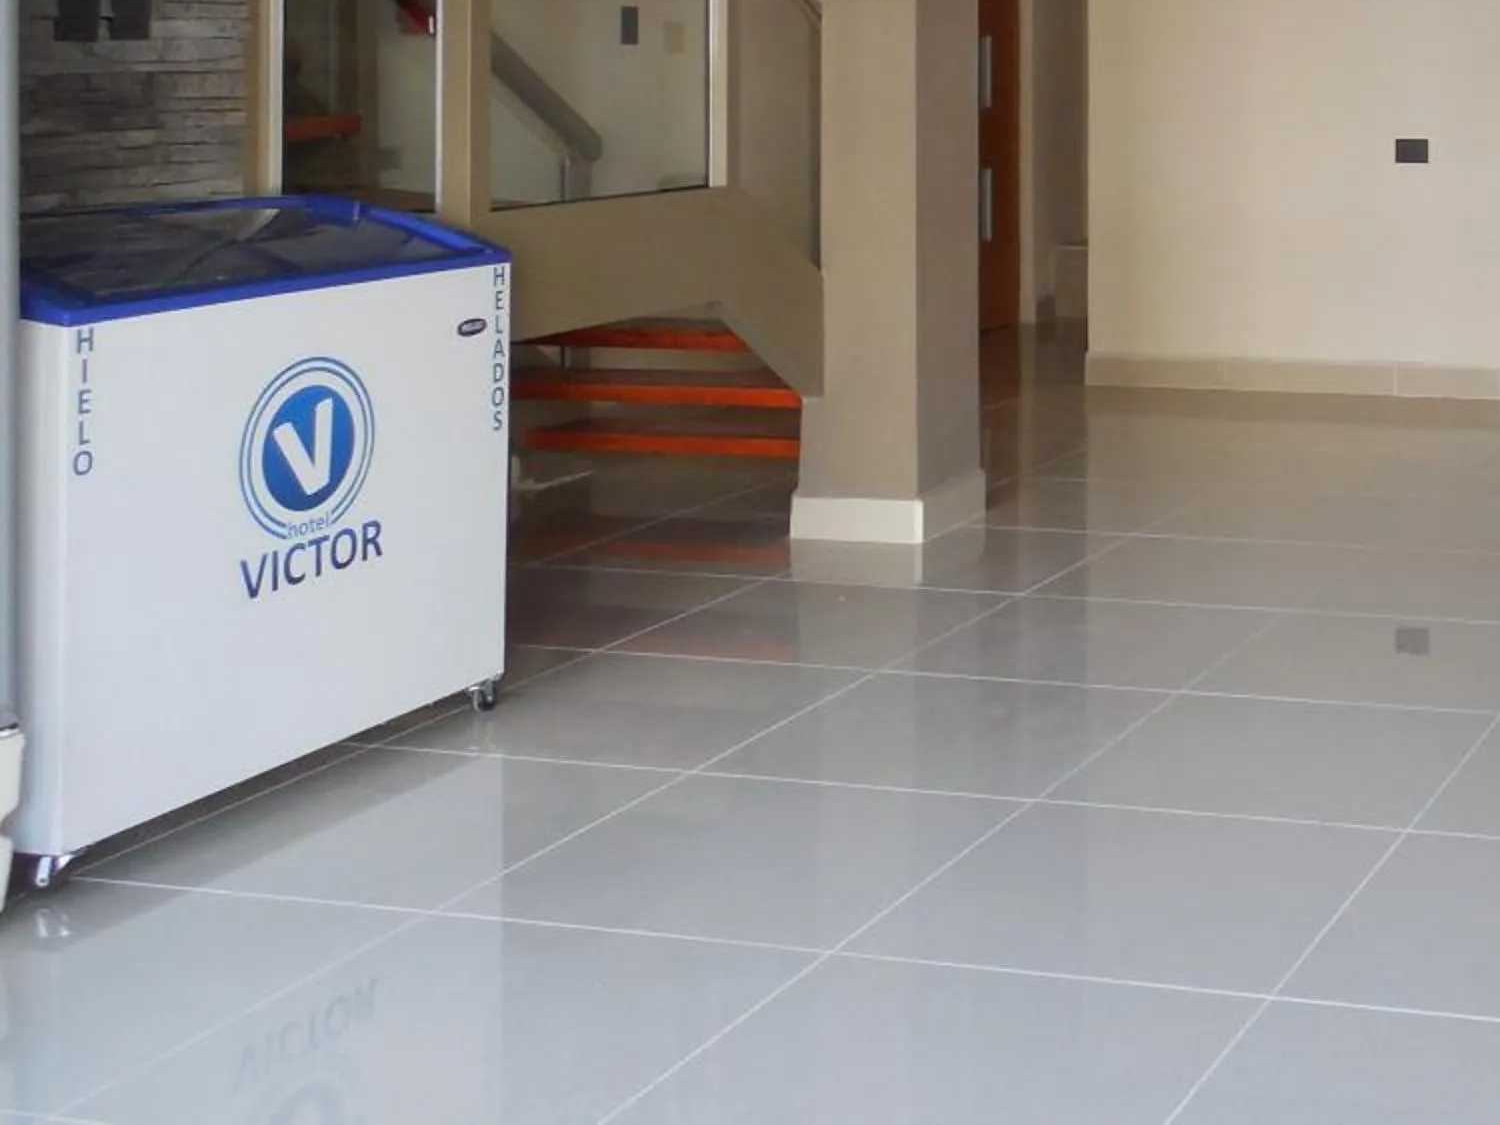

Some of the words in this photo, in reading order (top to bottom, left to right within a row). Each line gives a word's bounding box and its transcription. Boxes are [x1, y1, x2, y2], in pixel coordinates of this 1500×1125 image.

[492, 266, 506, 431] HELADOS
[73, 328, 94, 476] HIELO
[272, 398, 334, 496] V
[240, 520, 383, 600] VICTOR
[287, 511, 329, 538] hotel
